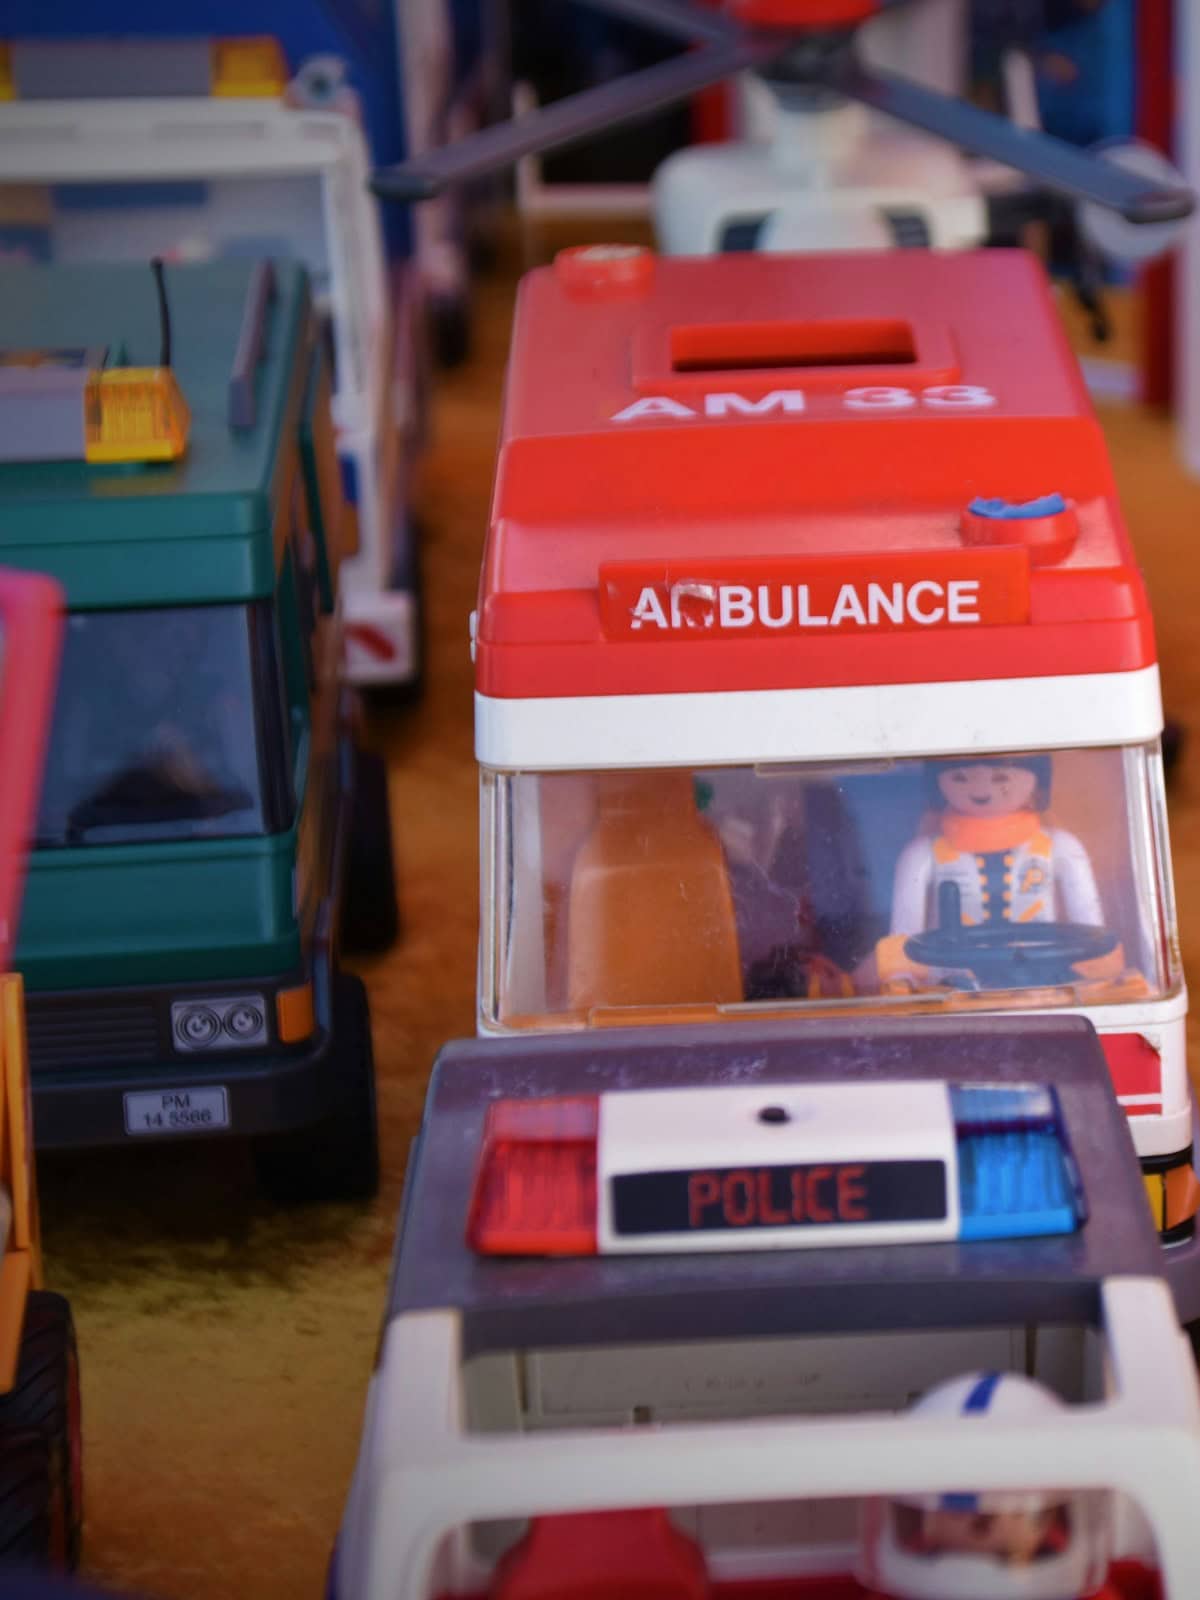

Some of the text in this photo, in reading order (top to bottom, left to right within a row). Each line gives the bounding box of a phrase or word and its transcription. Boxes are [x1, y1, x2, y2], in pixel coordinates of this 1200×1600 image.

[610, 385, 997, 423] AM 33
[161, 1094, 191, 1110] PM
[687, 1164, 869, 1228] POLICE
